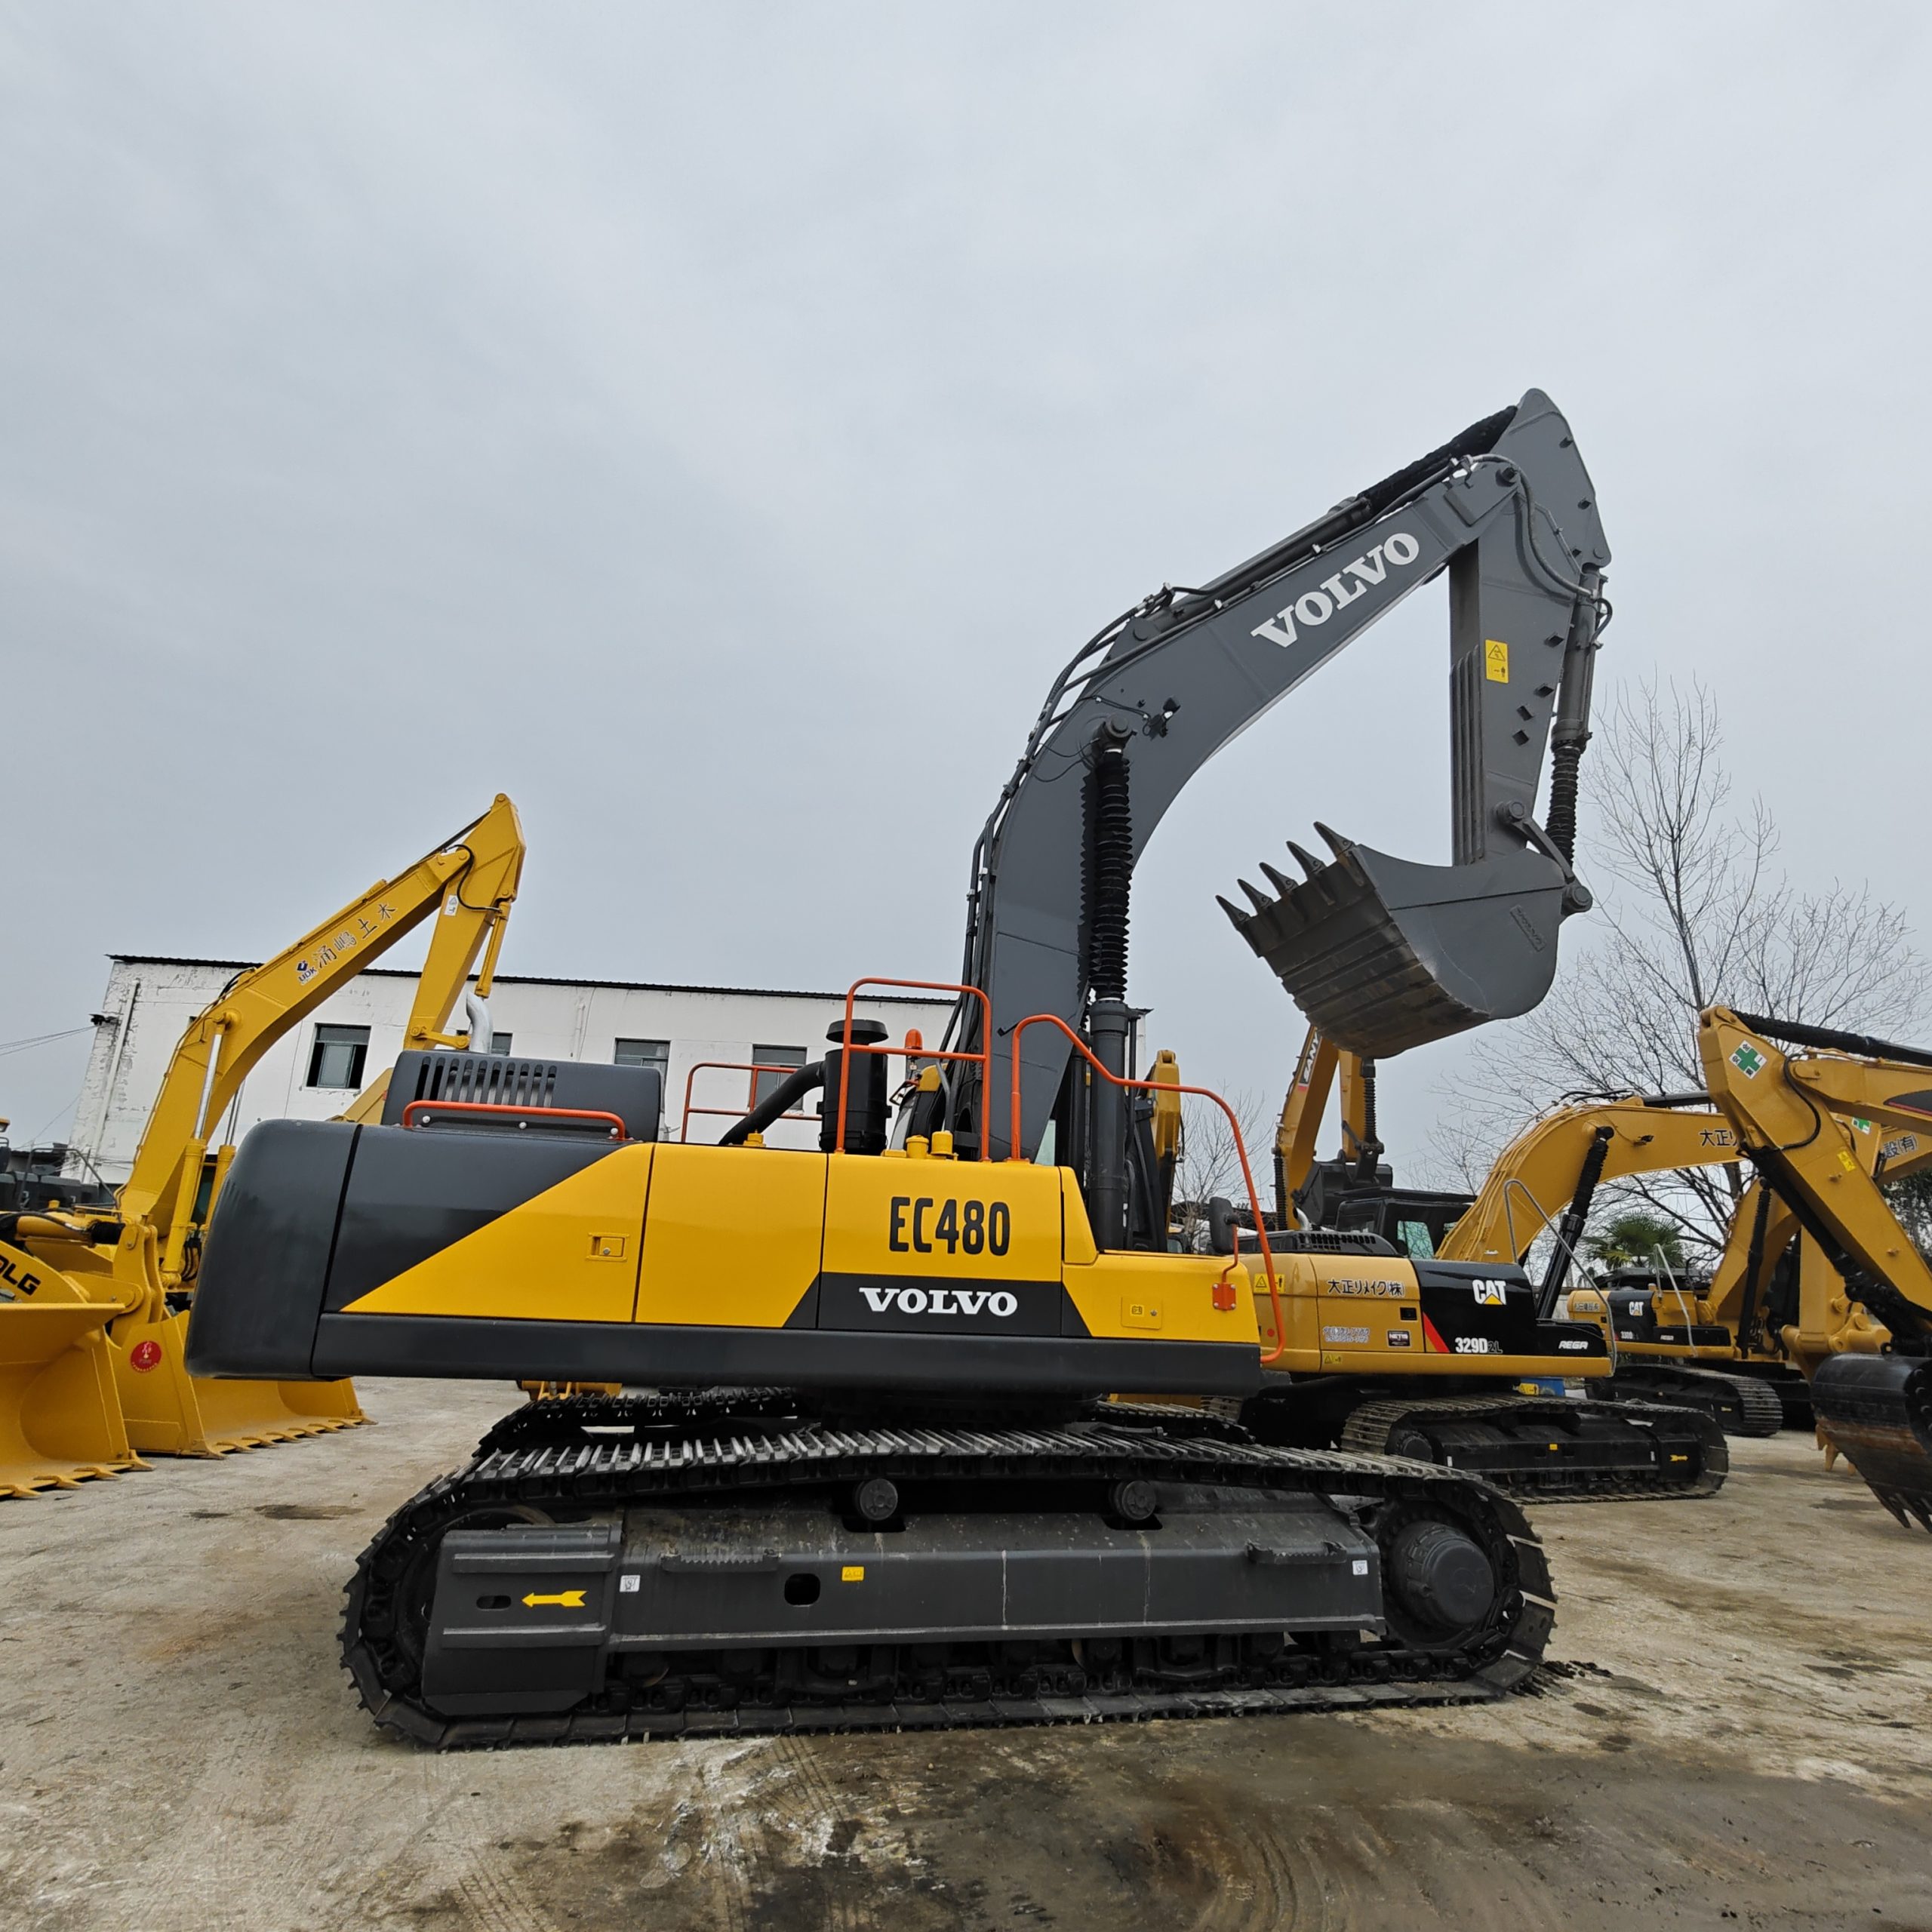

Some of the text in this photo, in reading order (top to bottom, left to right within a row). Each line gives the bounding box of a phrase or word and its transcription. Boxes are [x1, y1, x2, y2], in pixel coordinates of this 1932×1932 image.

[1250, 533, 1420, 648] VOLVO
[298, 967, 317, 982] UDK
[1303, 1030, 1319, 1083] SANY
[889, 1196, 1011, 1257] EC480
[858, 1287, 1018, 1317] VOLVO
[1472, 1279, 1506, 1306] CAT
[1629, 1301, 1644, 1316] CAT
[1558, 1340, 1589, 1350] REGA
